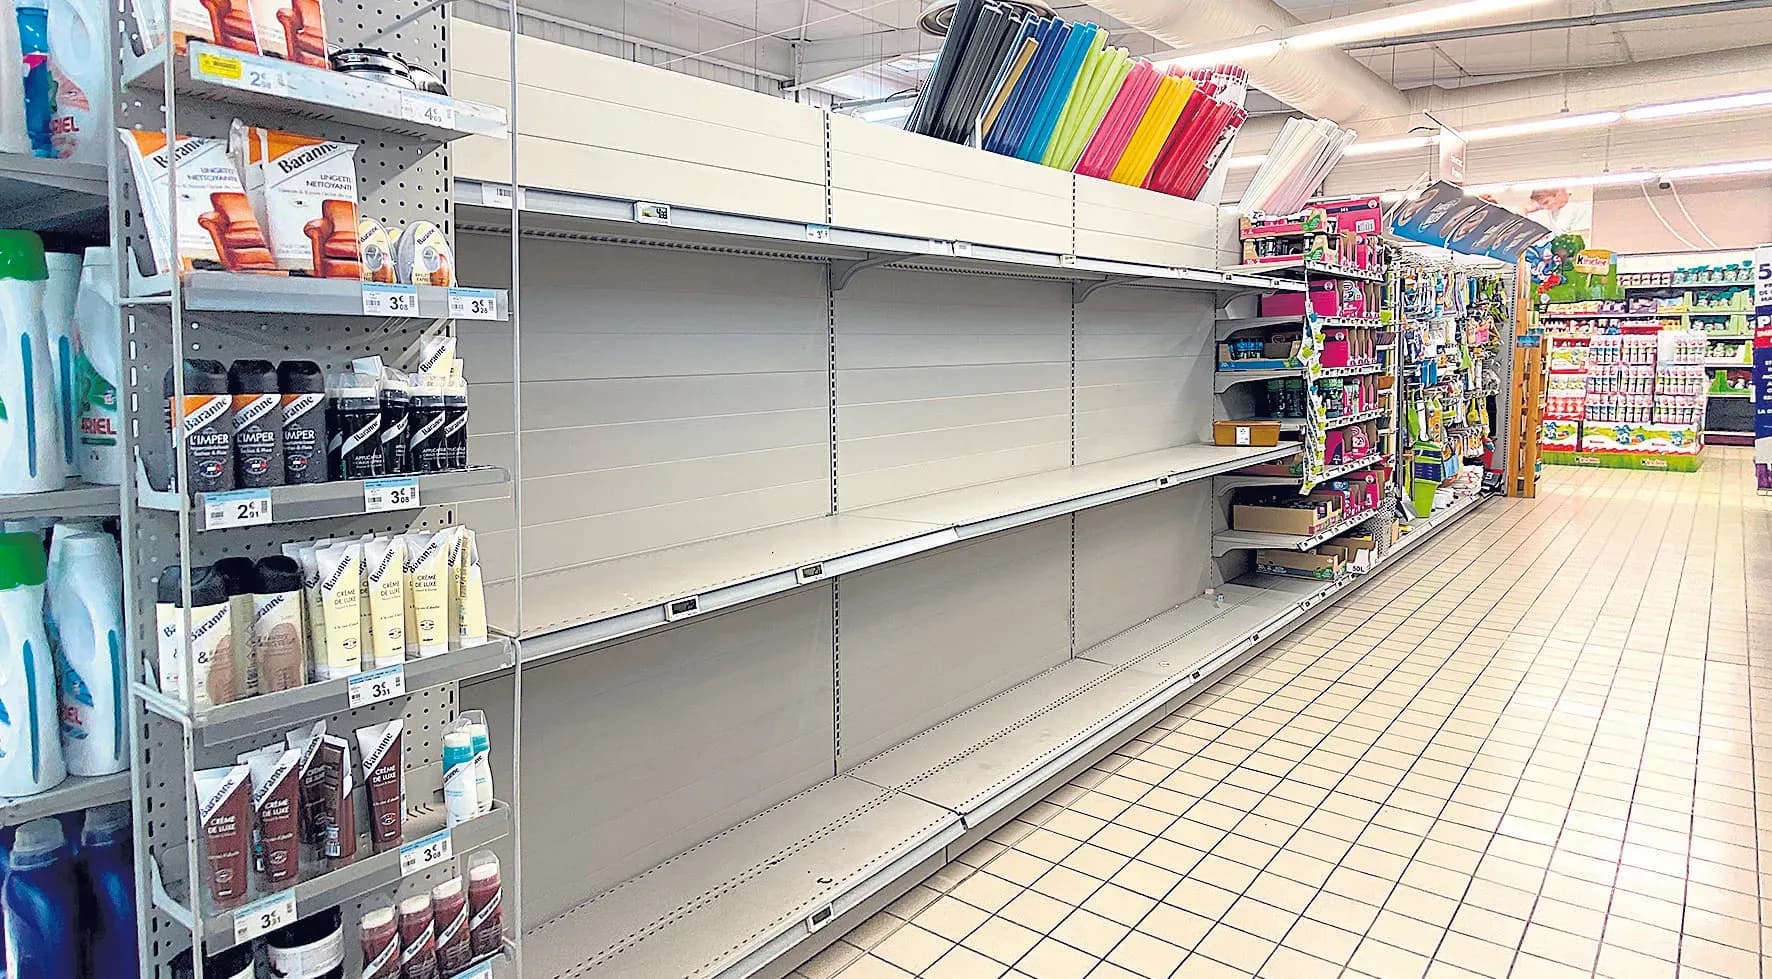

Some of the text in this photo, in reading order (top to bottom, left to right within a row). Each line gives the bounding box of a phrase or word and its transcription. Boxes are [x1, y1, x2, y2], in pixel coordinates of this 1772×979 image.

[190, 433, 229, 446] L'IMPER
[322, 554, 352, 592] Baranne
[363, 732, 394, 770] Baranne
